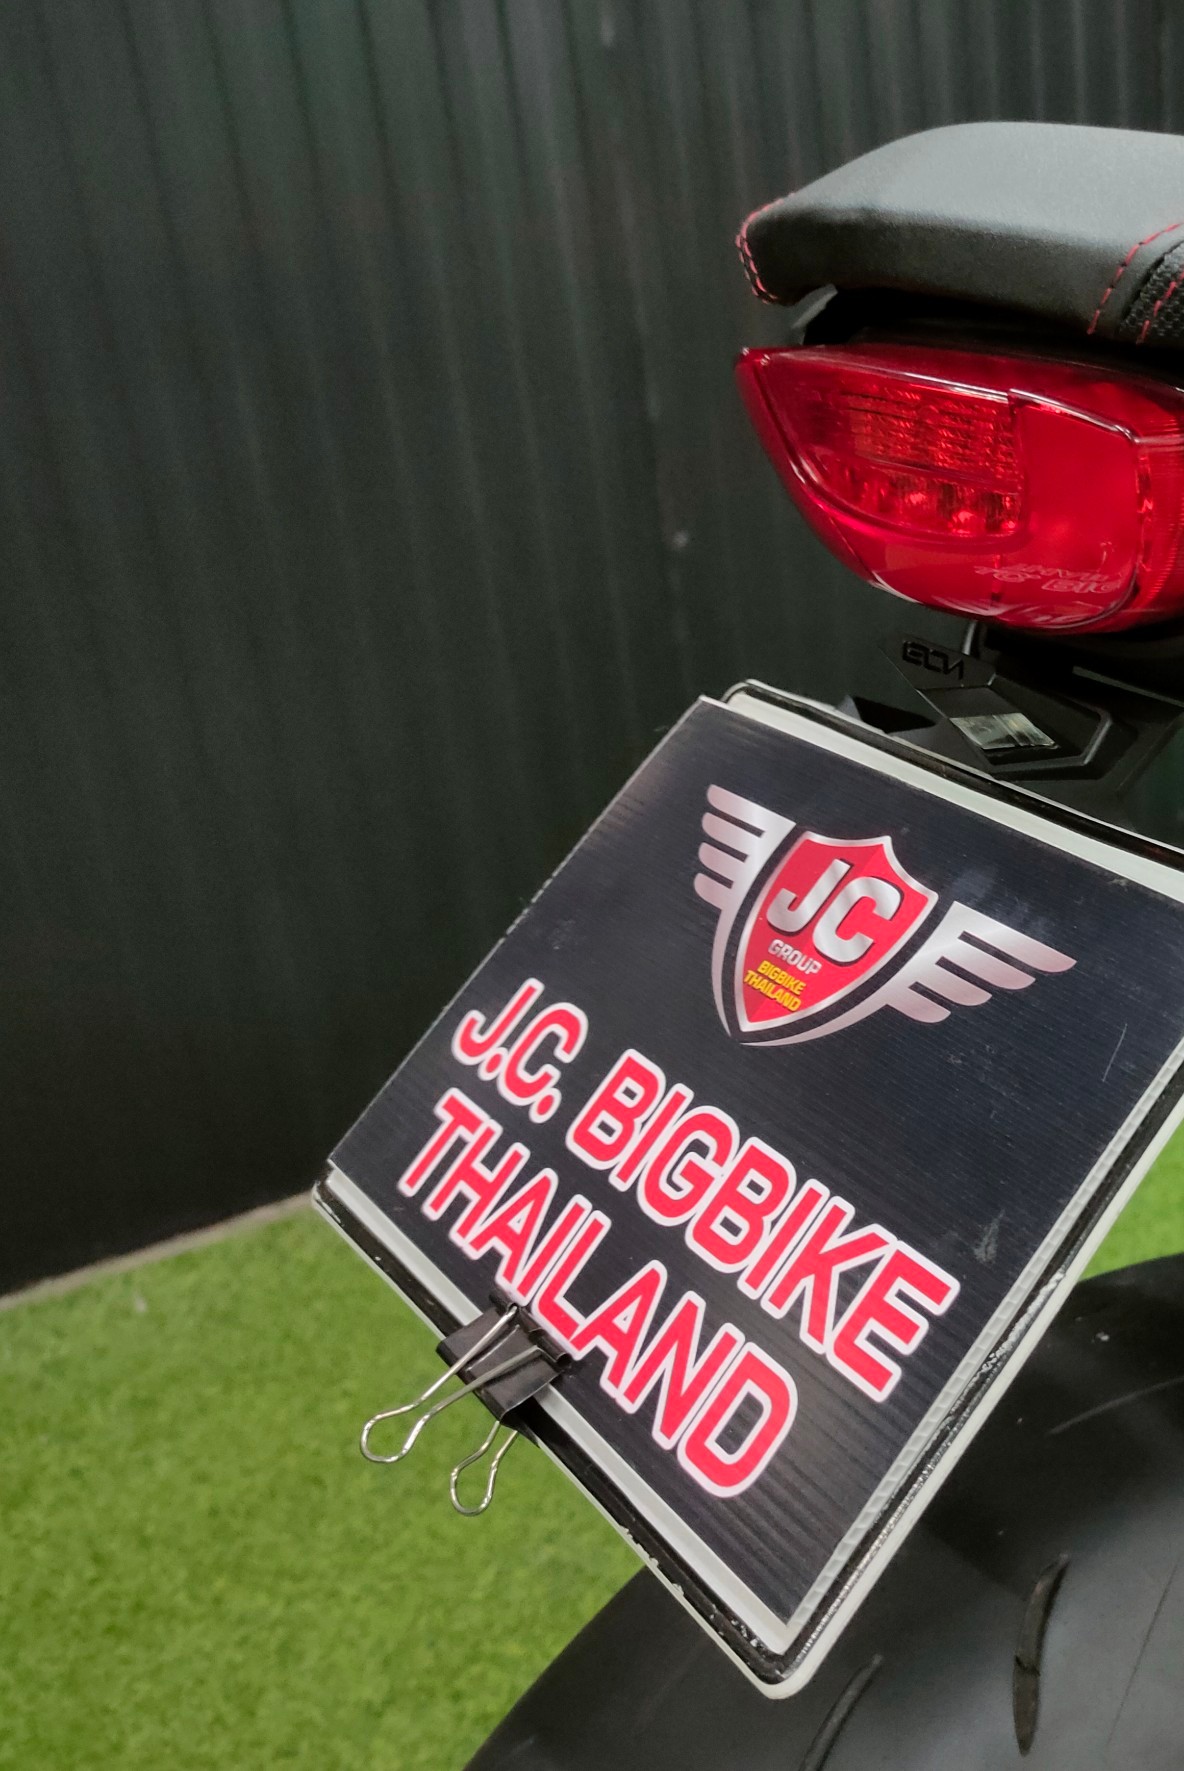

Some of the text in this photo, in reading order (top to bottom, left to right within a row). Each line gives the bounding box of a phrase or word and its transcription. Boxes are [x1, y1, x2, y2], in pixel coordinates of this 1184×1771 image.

[767, 858, 904, 965] JC
[744, 970, 801, 1012] THAILAND
[757, 961, 806, 995] BIGBIKE
[768, 939, 822, 975] GROUP
[451, 978, 960, 1402] J.C. BIGBIKE
[398, 1087, 798, 1498] THAILAND
